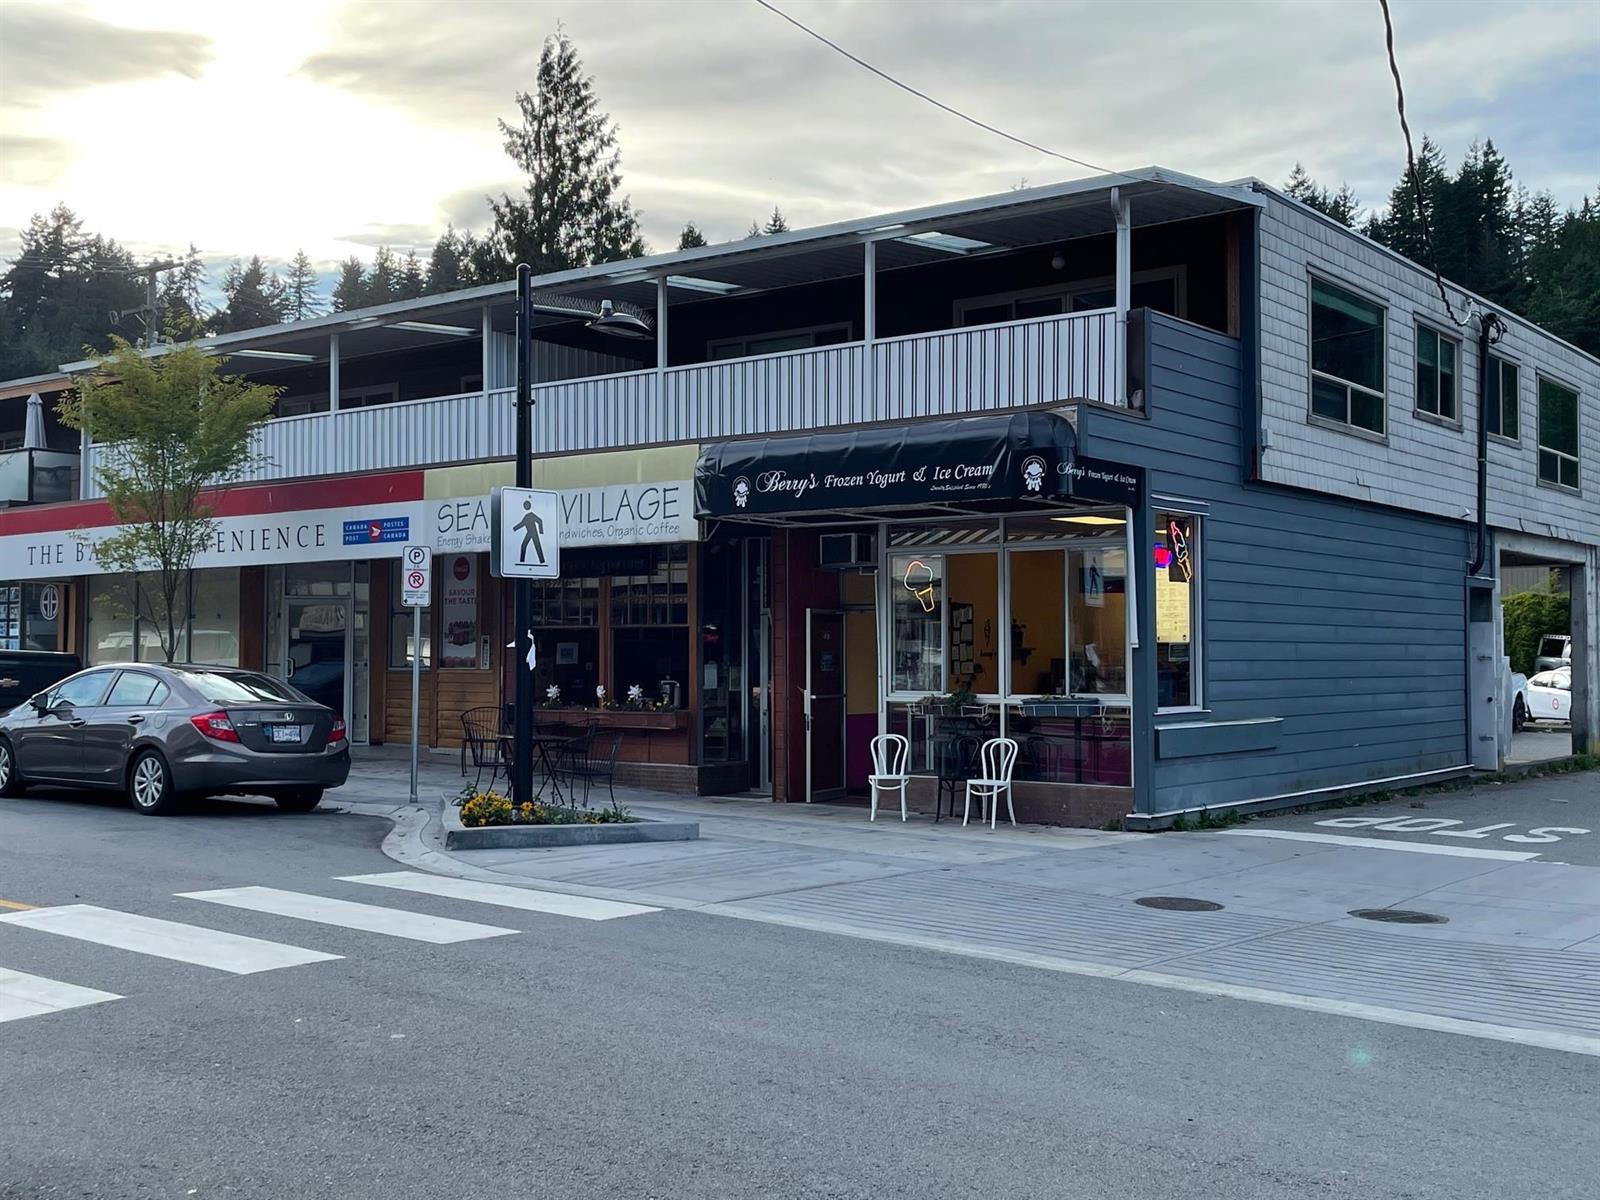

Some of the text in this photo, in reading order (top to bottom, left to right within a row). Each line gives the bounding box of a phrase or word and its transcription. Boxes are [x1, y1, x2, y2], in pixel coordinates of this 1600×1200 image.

[755, 470, 820, 498] Berry's
[824, 475, 864, 488] Frozen
[866, 470, 906, 489] Yogurt
[933, 466, 952, 480] Ice
[954, 464, 993, 480] Cream
[561, 487, 680, 524] VILLAGE
[437, 535, 463, 549] Energy
[465, 533, 491, 545] Shake
[606, 525, 644, 540] Organic
[646, 521, 680, 536] Coffee
[27, 543, 64, 566] THE
[1313, 815, 1592, 844] STOP
